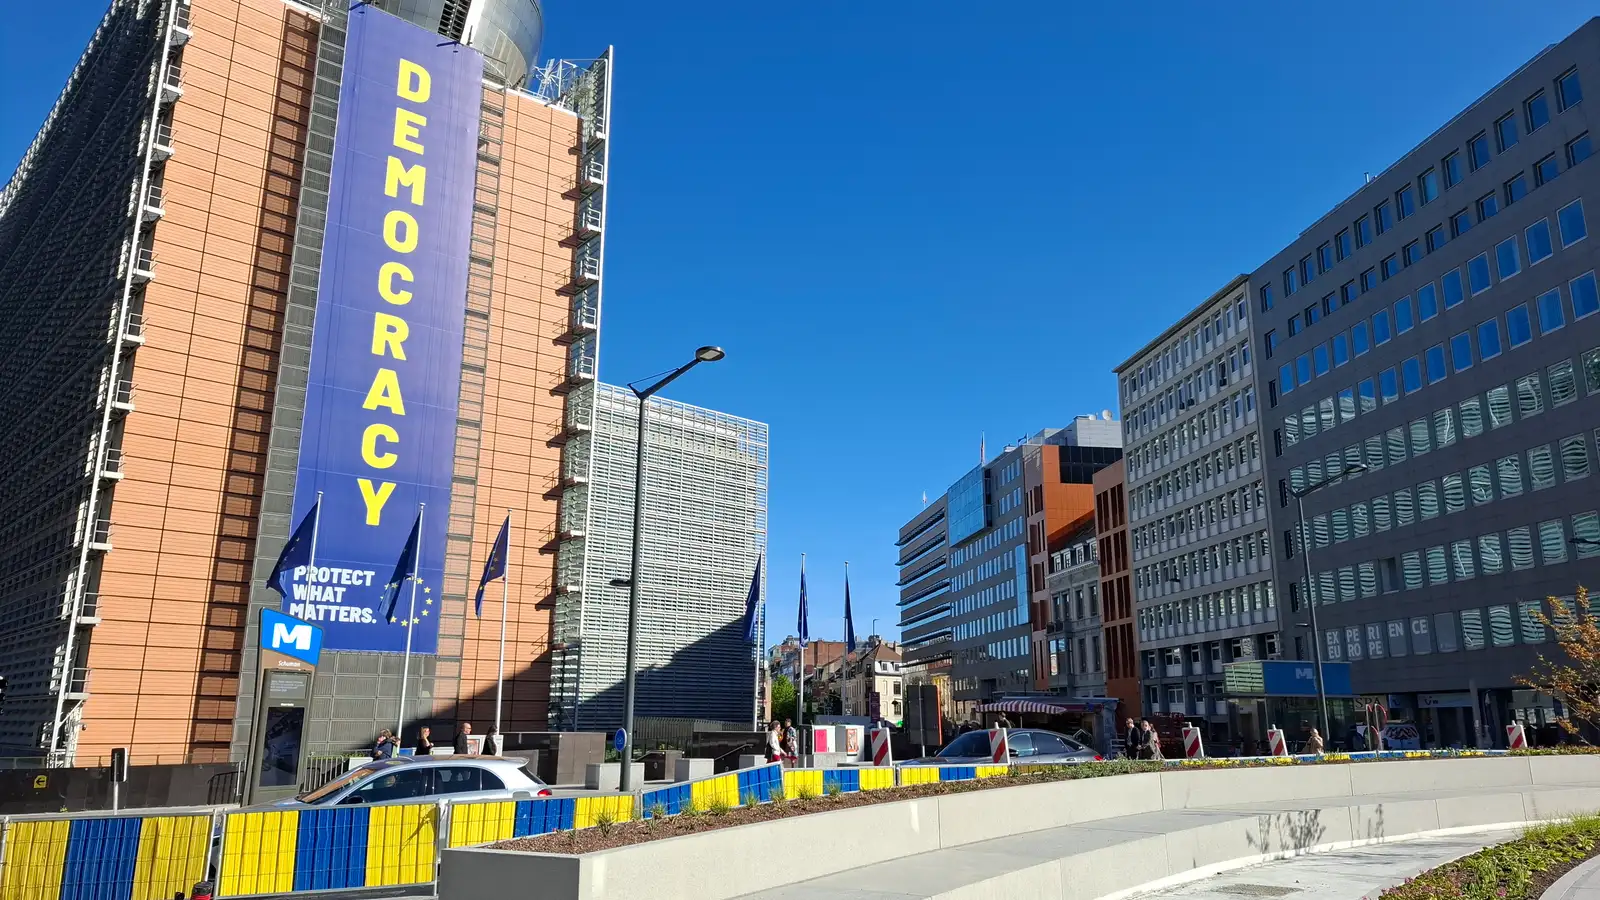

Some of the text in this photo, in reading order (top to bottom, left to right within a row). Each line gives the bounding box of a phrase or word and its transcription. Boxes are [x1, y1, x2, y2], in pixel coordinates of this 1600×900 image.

[356, 58, 431, 526] DEMOCRACY
[294, 565, 375, 586] PROTECT
[292, 584, 346, 602] WHAT
[290, 603, 377, 623] MATTERS.
